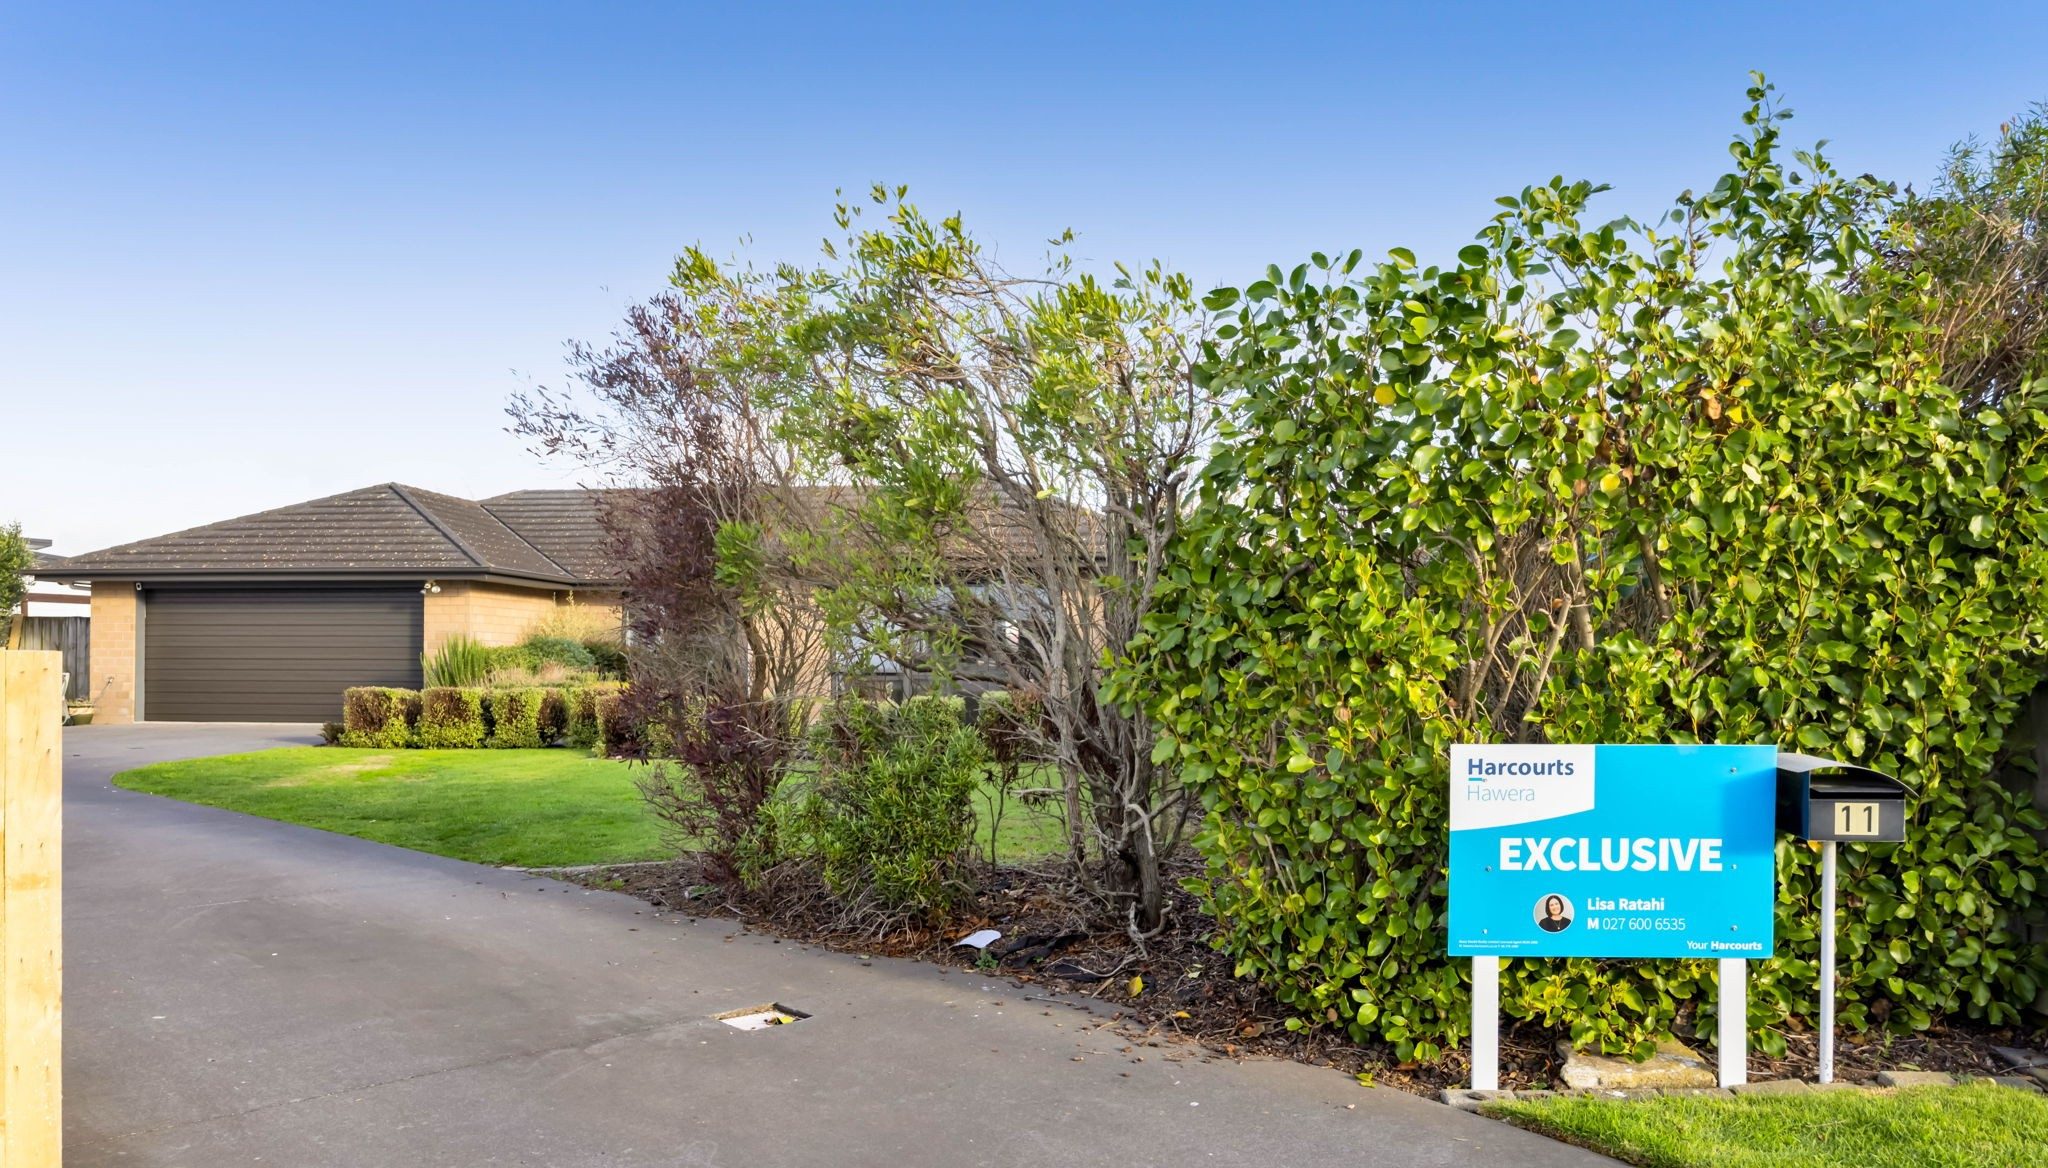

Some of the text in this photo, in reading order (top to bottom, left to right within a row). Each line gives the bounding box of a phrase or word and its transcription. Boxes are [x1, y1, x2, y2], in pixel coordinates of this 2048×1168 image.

[1468, 758, 1575, 776] Harcourts
[1467, 785, 1535, 802] Hawera
[1841, 805, 1873, 833] 11
[1499, 837, 1723, 872] EXCLUSIVE
[1587, 897, 1665, 911] Lisa Ratahi
[1587, 917, 1686, 931] M 027 600 6535
[1686, 940, 1763, 951] Your Harcourts
